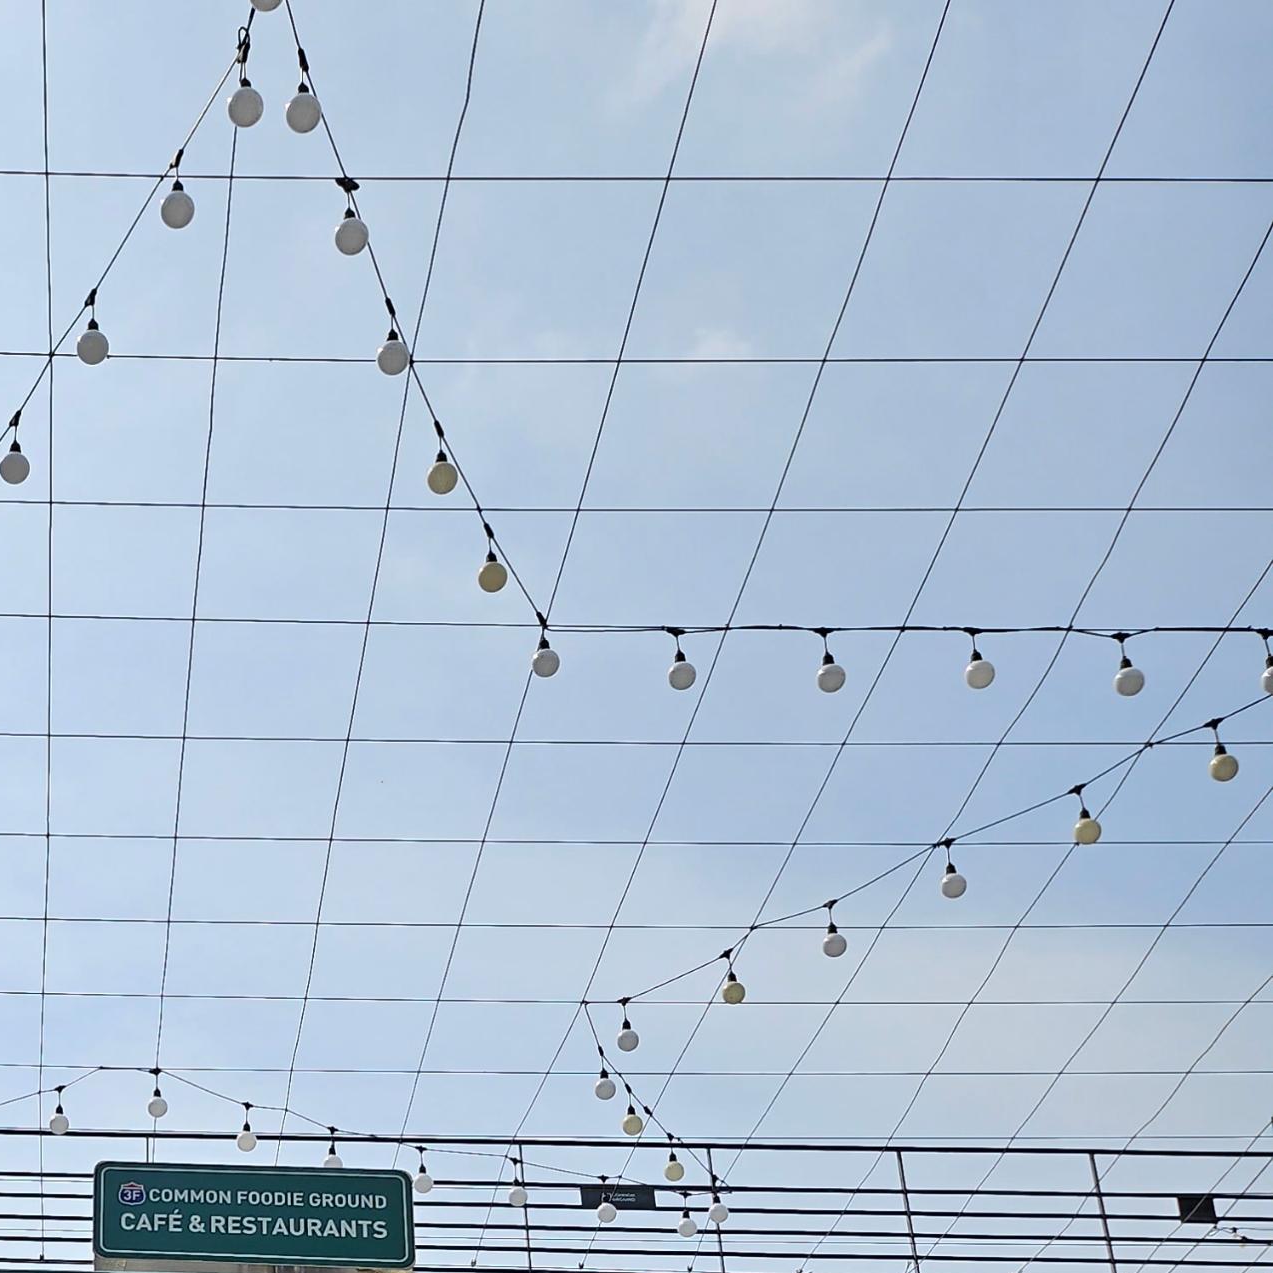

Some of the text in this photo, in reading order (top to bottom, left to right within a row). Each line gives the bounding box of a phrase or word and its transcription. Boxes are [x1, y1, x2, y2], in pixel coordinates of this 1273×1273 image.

[122, 1188, 388, 1209] 3F COMMON FOODIE GROUND
[120, 1209, 388, 1239] CAFÉ & RESTAURANTS
